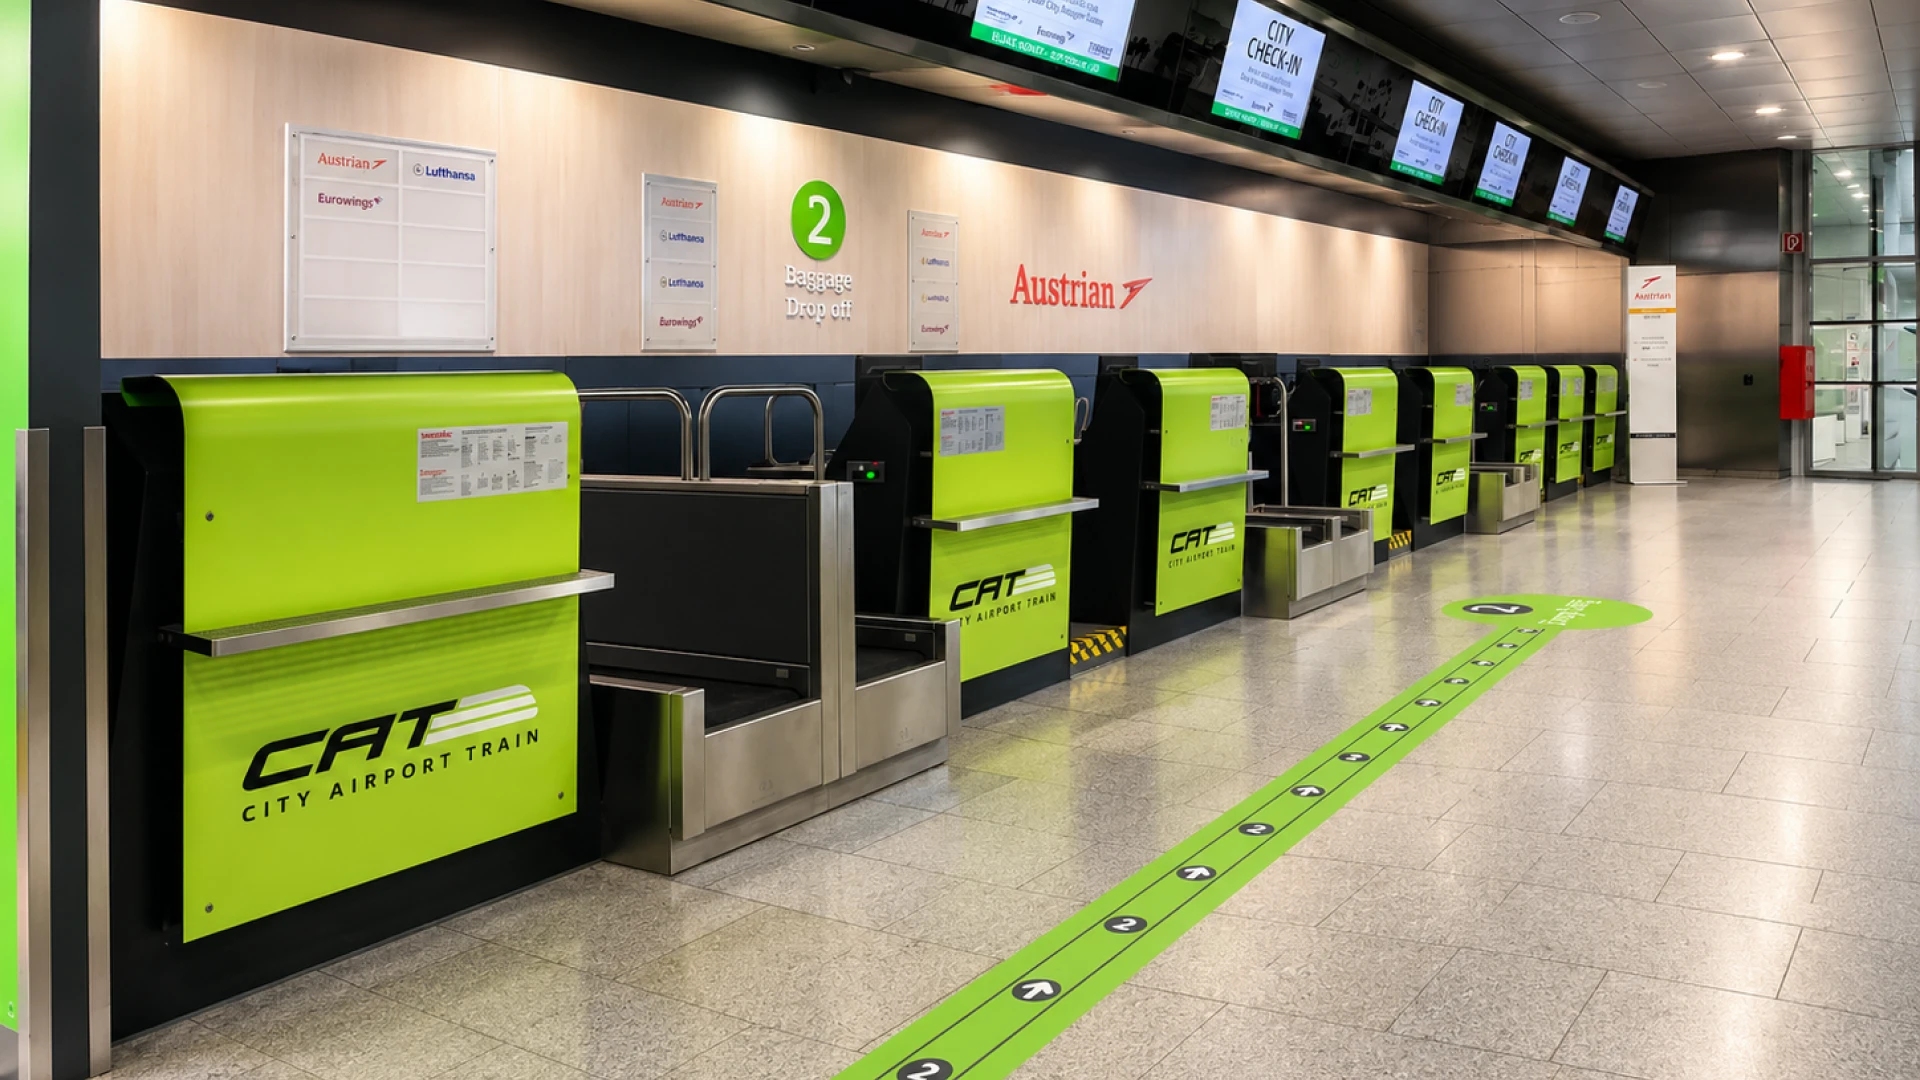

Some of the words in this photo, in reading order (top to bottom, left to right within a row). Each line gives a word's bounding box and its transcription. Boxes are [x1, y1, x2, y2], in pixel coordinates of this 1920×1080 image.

[1267, 19, 1294, 46] CITY
[1247, 37, 1302, 76] CHECK-IN
[1429, 96, 1445, 115] CITY
[317, 152, 371, 170] Austrian
[425, 165, 476, 182] Lufthansa
[317, 193, 374, 211] Eurowings
[808, 194, 832, 245] 2
[784, 264, 853, 295] Baggage
[1009, 263, 1116, 309] Austrian
[659, 316, 697, 330] Eurowings
[785, 297, 827, 325] Drop
[831, 300, 853, 320] off
[1348, 486, 1377, 507] CAT
[1170, 524, 1217, 554] CAT
[949, 568, 1027, 613] CAT
[976, 601, 1022, 623] AIRPORT
[1027, 592, 1057, 609] TRAIN
[242, 698, 459, 792] CAT
[242, 791, 311, 822] CITY
[329, 752, 452, 800] AIRPORT
[466, 728, 539, 760] TRAIN
[1246, 824, 1267, 834] 2
[1112, 918, 1137, 931] 2
[907, 1062, 940, 1080] 2
